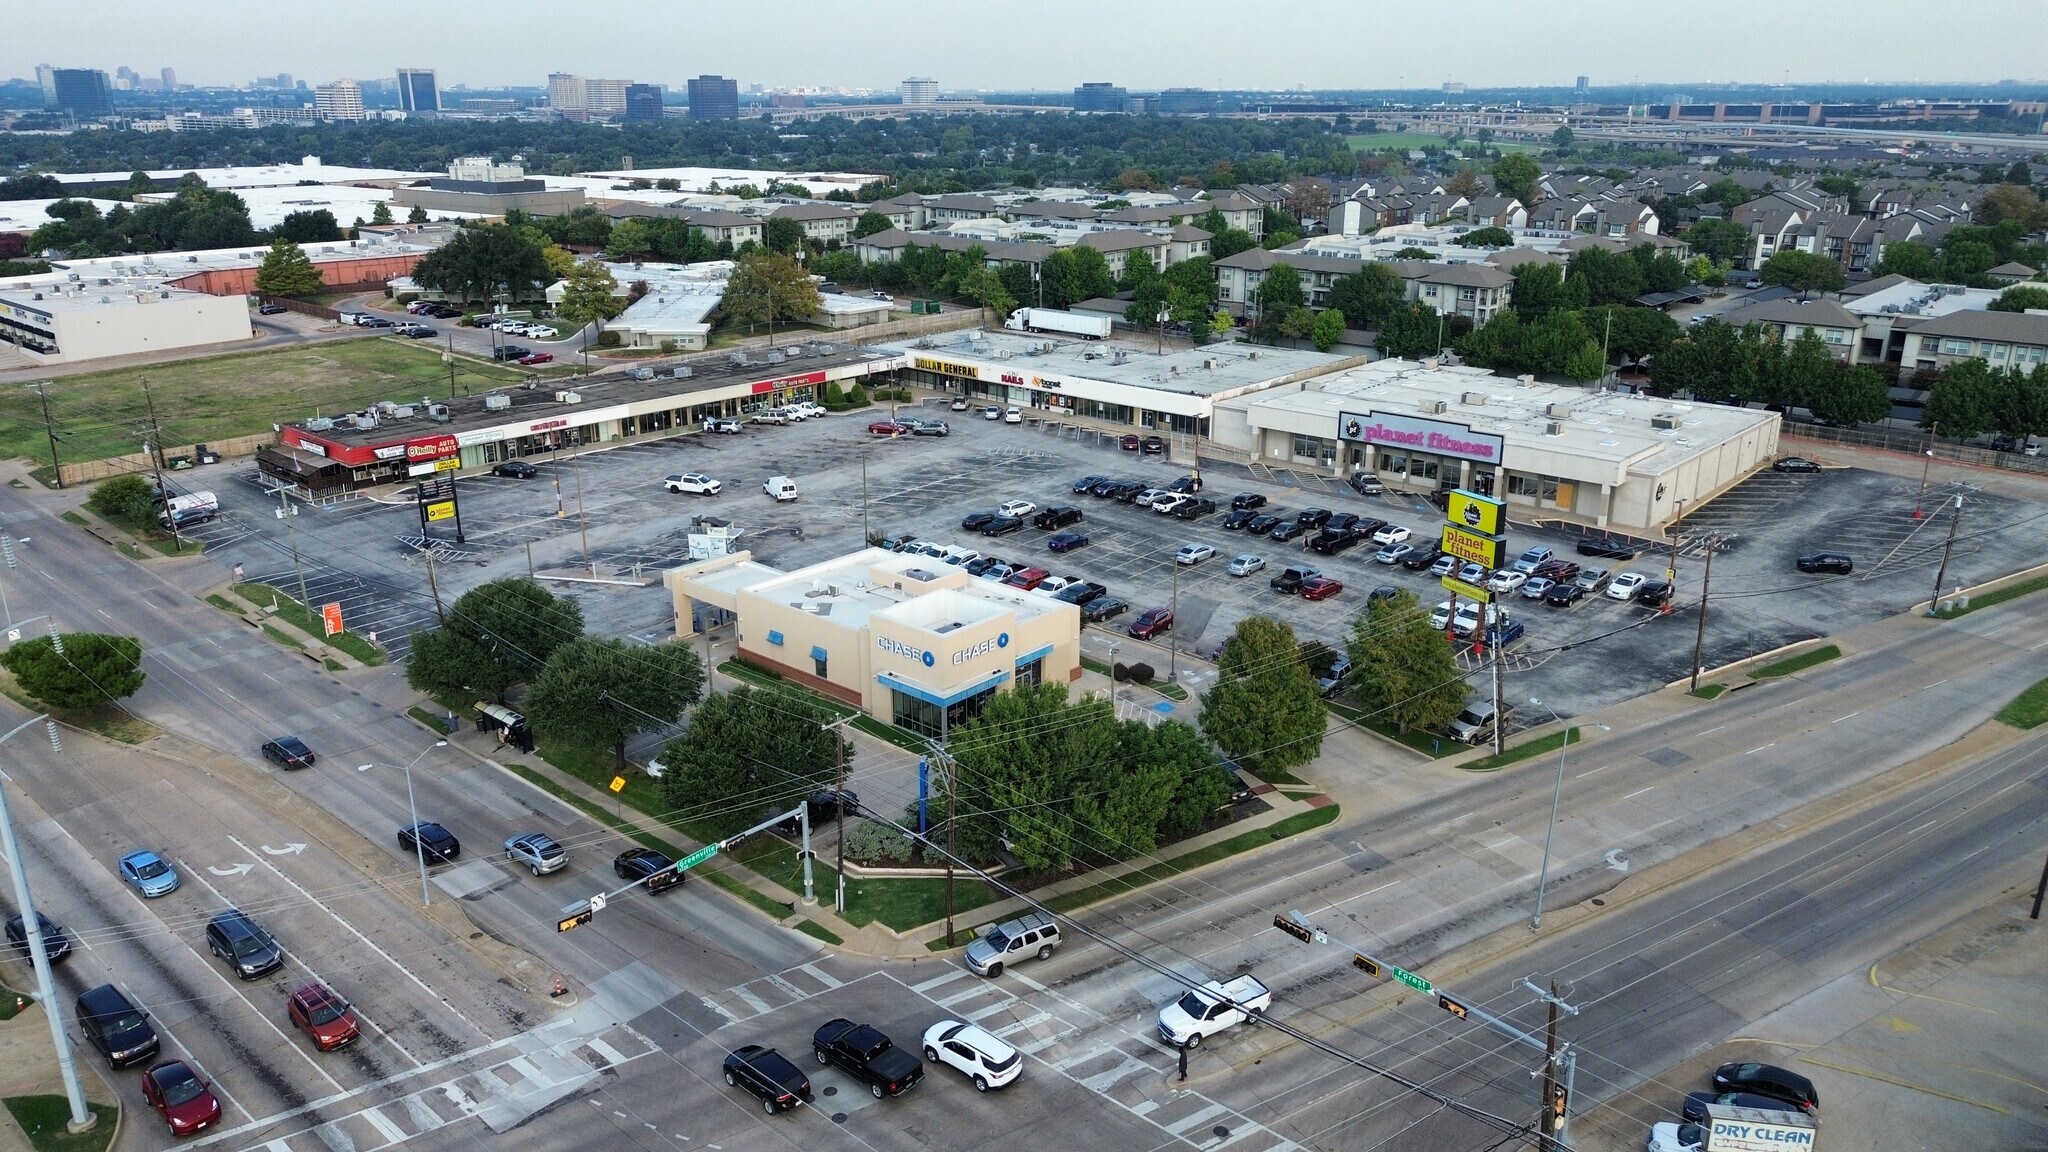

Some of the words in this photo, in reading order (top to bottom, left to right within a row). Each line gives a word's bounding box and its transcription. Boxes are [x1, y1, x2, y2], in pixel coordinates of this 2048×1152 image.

[915, 359, 943, 372] DOLLAR
[943, 363, 977, 378] GENERAL
[1001, 374, 1024, 385] NAILS
[1041, 378, 1061, 388] boost
[438, 445, 456, 454] PARTS
[439, 439, 454, 447] AUTO
[1364, 423, 1425, 446] planet
[1427, 432, 1494, 457] fitness
[1446, 530, 1485, 551] planet
[1450, 542, 1490, 566] fitness
[877, 636, 922, 662] CHASE
[953, 638, 997, 665] CHASE
[679, 845, 716, 868] Greenville
[1398, 970, 1426, 988] Forest
[1713, 1123, 1751, 1139] DRY
[1754, 1128, 1812, 1144] CLEAN
